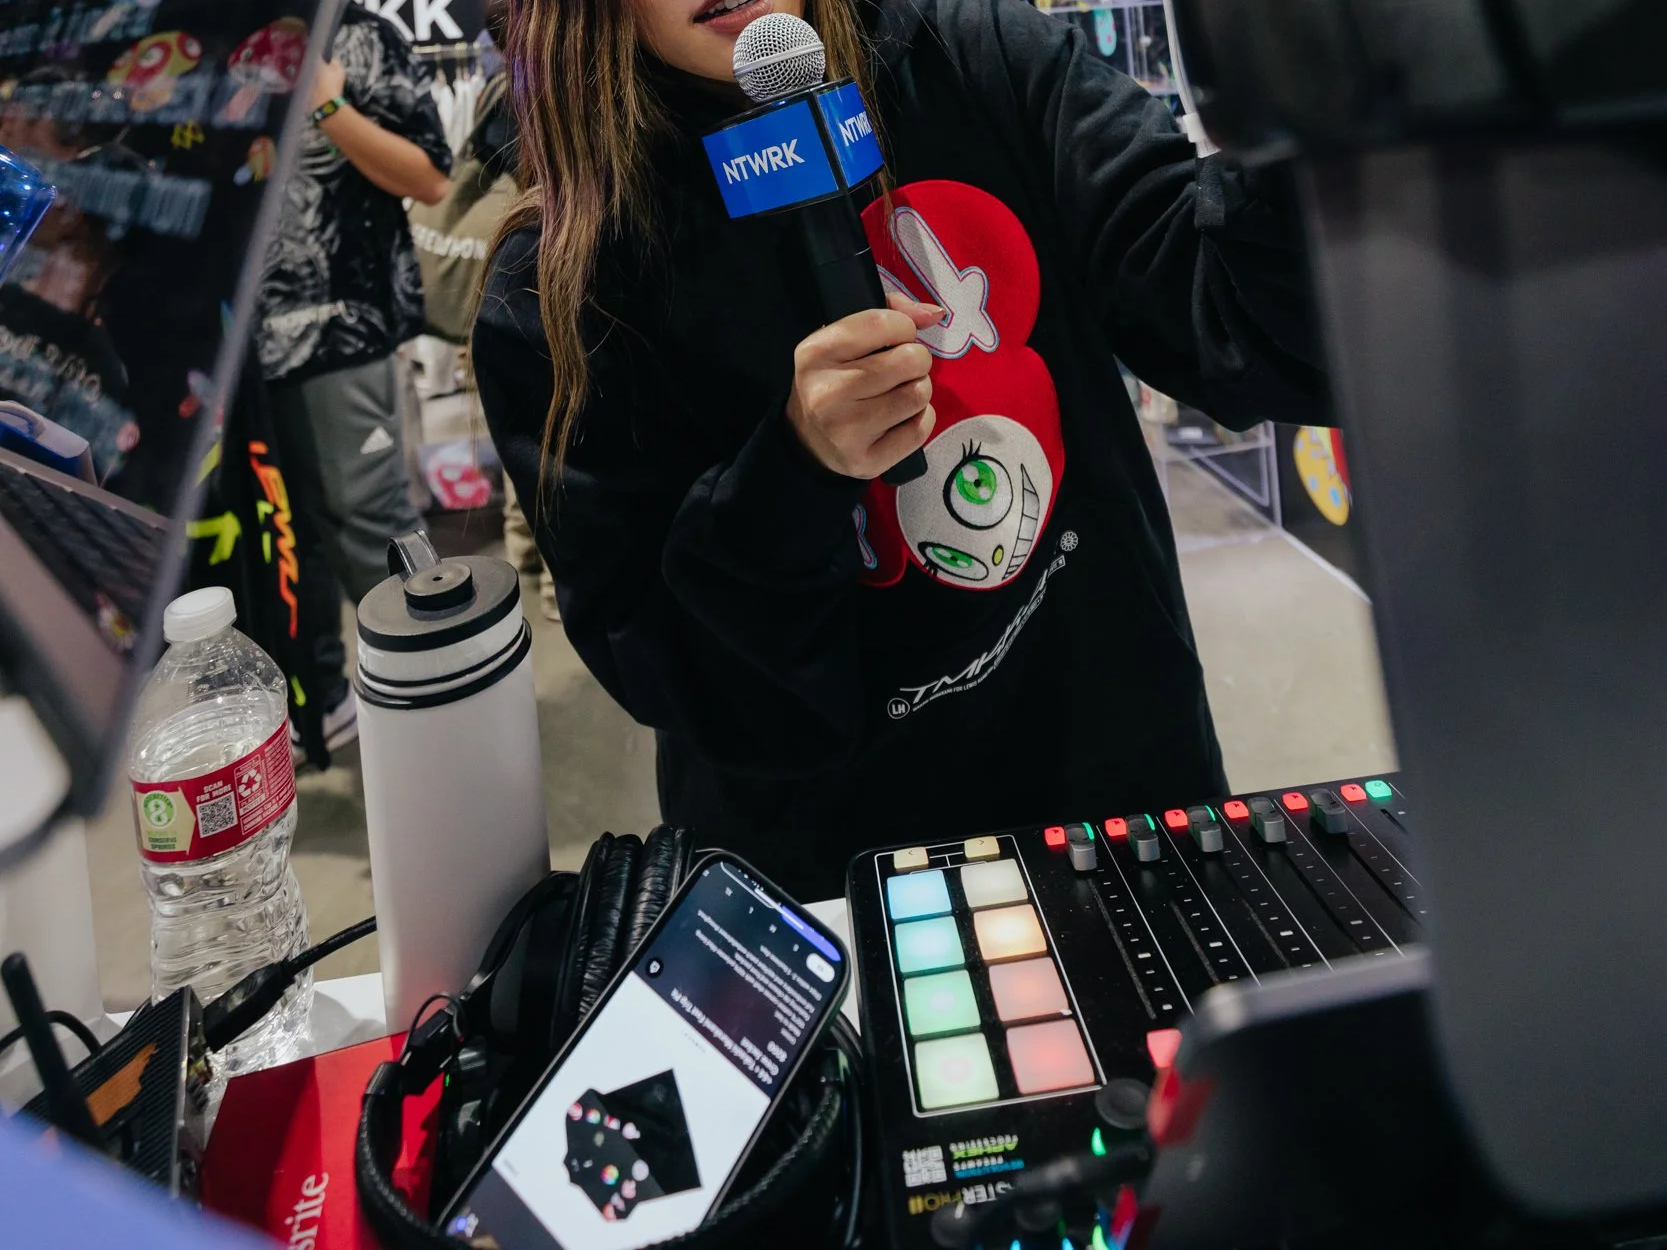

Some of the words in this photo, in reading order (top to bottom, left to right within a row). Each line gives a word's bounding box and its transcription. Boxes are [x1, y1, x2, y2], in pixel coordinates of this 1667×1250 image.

[722, 138, 805, 185] NTWRK
[890, 702, 907, 717] LH
[196, 793, 211, 803] FOR
[212, 784, 232, 798] MORE
[203, 780, 224, 793] SCAN
